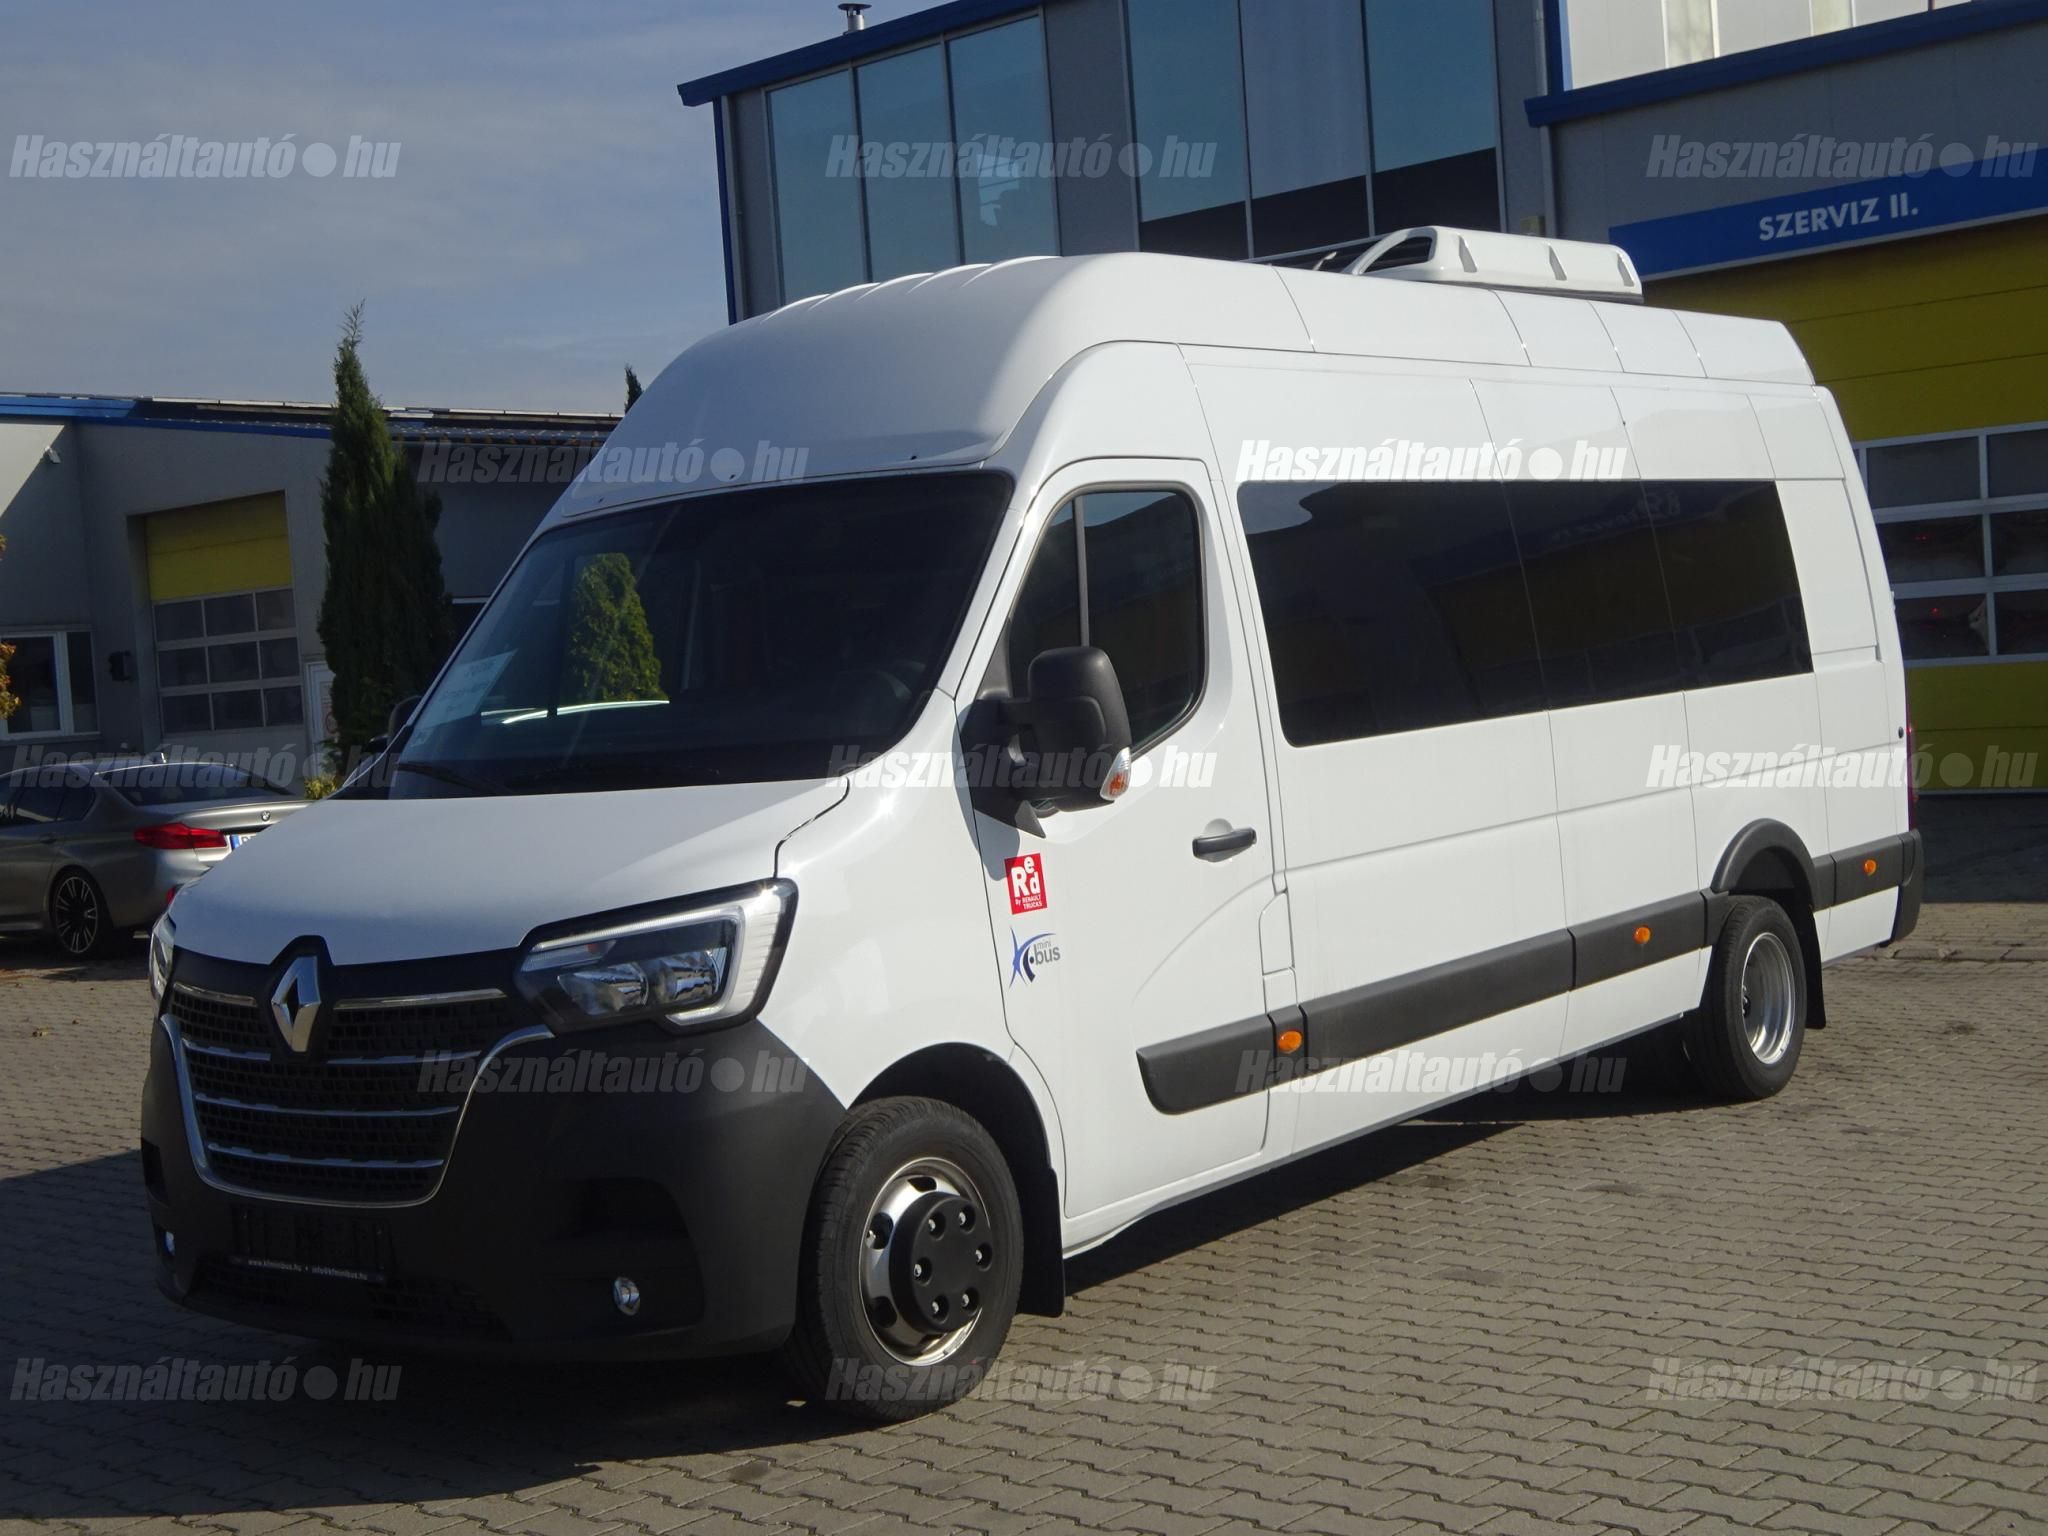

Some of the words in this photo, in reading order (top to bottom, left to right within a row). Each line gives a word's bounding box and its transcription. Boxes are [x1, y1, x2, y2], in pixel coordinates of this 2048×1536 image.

[1759, 197, 1879, 240] SZERVIZ
[1890, 192, 1918, 218] II.
[1022, 894, 1041, 903] RENAULT
[1023, 901, 1043, 910] TRUCKS
